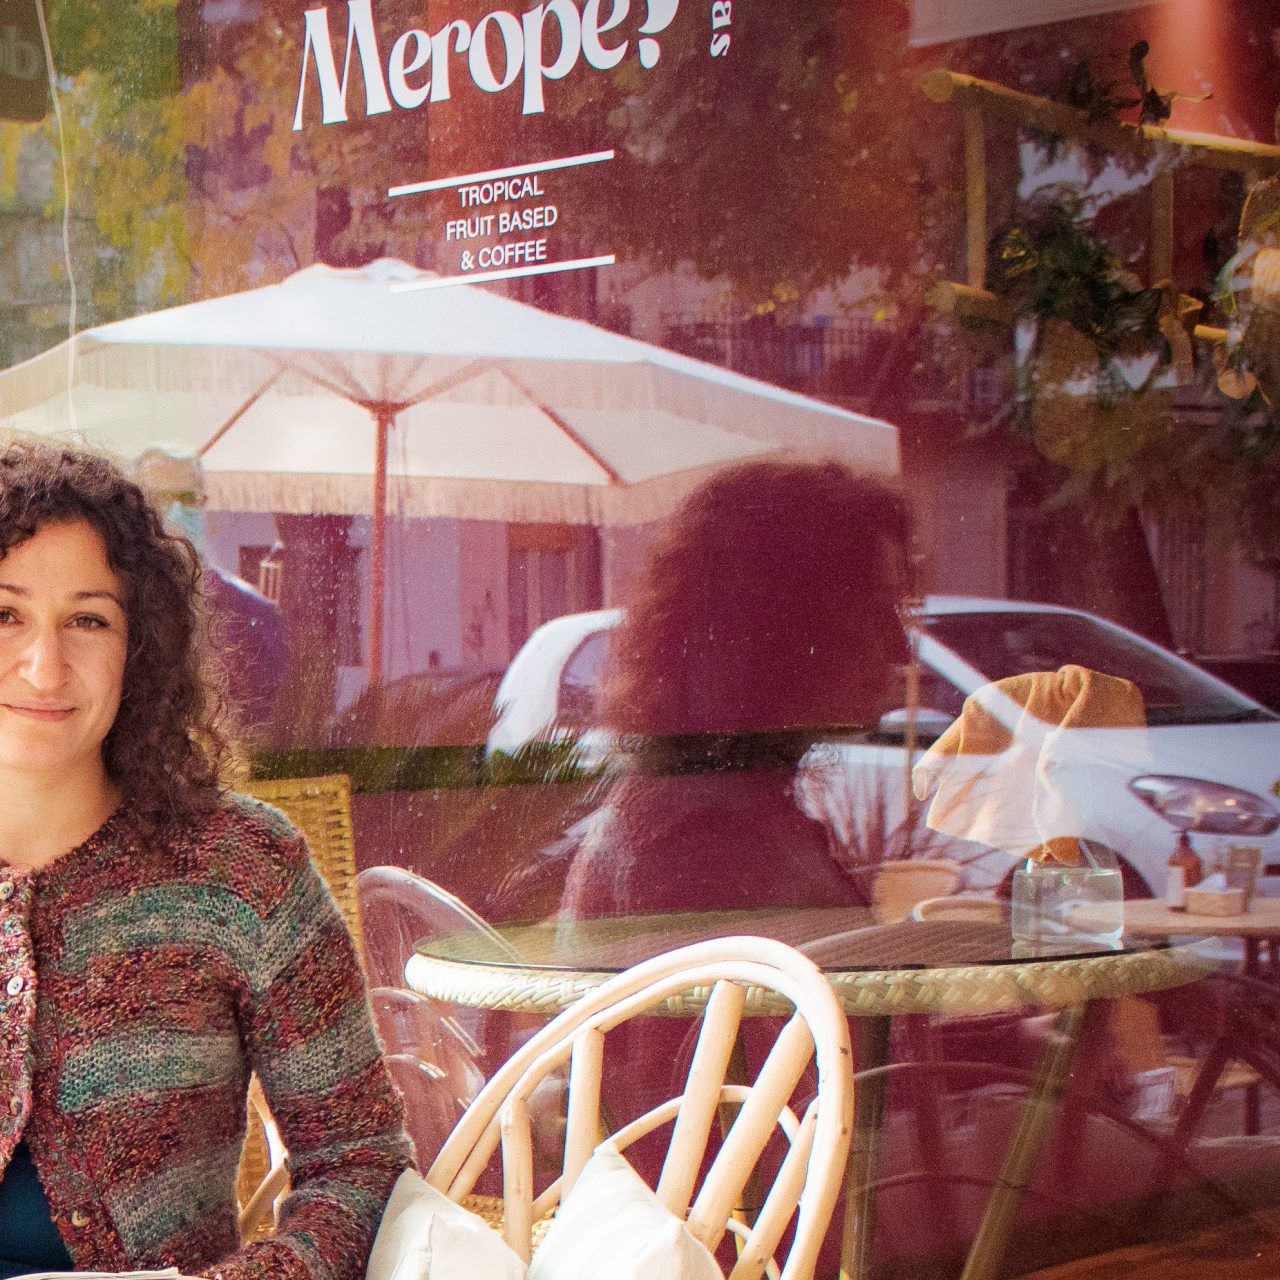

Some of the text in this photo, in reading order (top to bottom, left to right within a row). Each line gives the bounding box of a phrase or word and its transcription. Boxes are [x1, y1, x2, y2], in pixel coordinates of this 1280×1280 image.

[458, 176, 544, 207] TROPICAL
[446, 206, 558, 241] FRUIT BASED
[461, 238, 547, 271] & COFFEE
